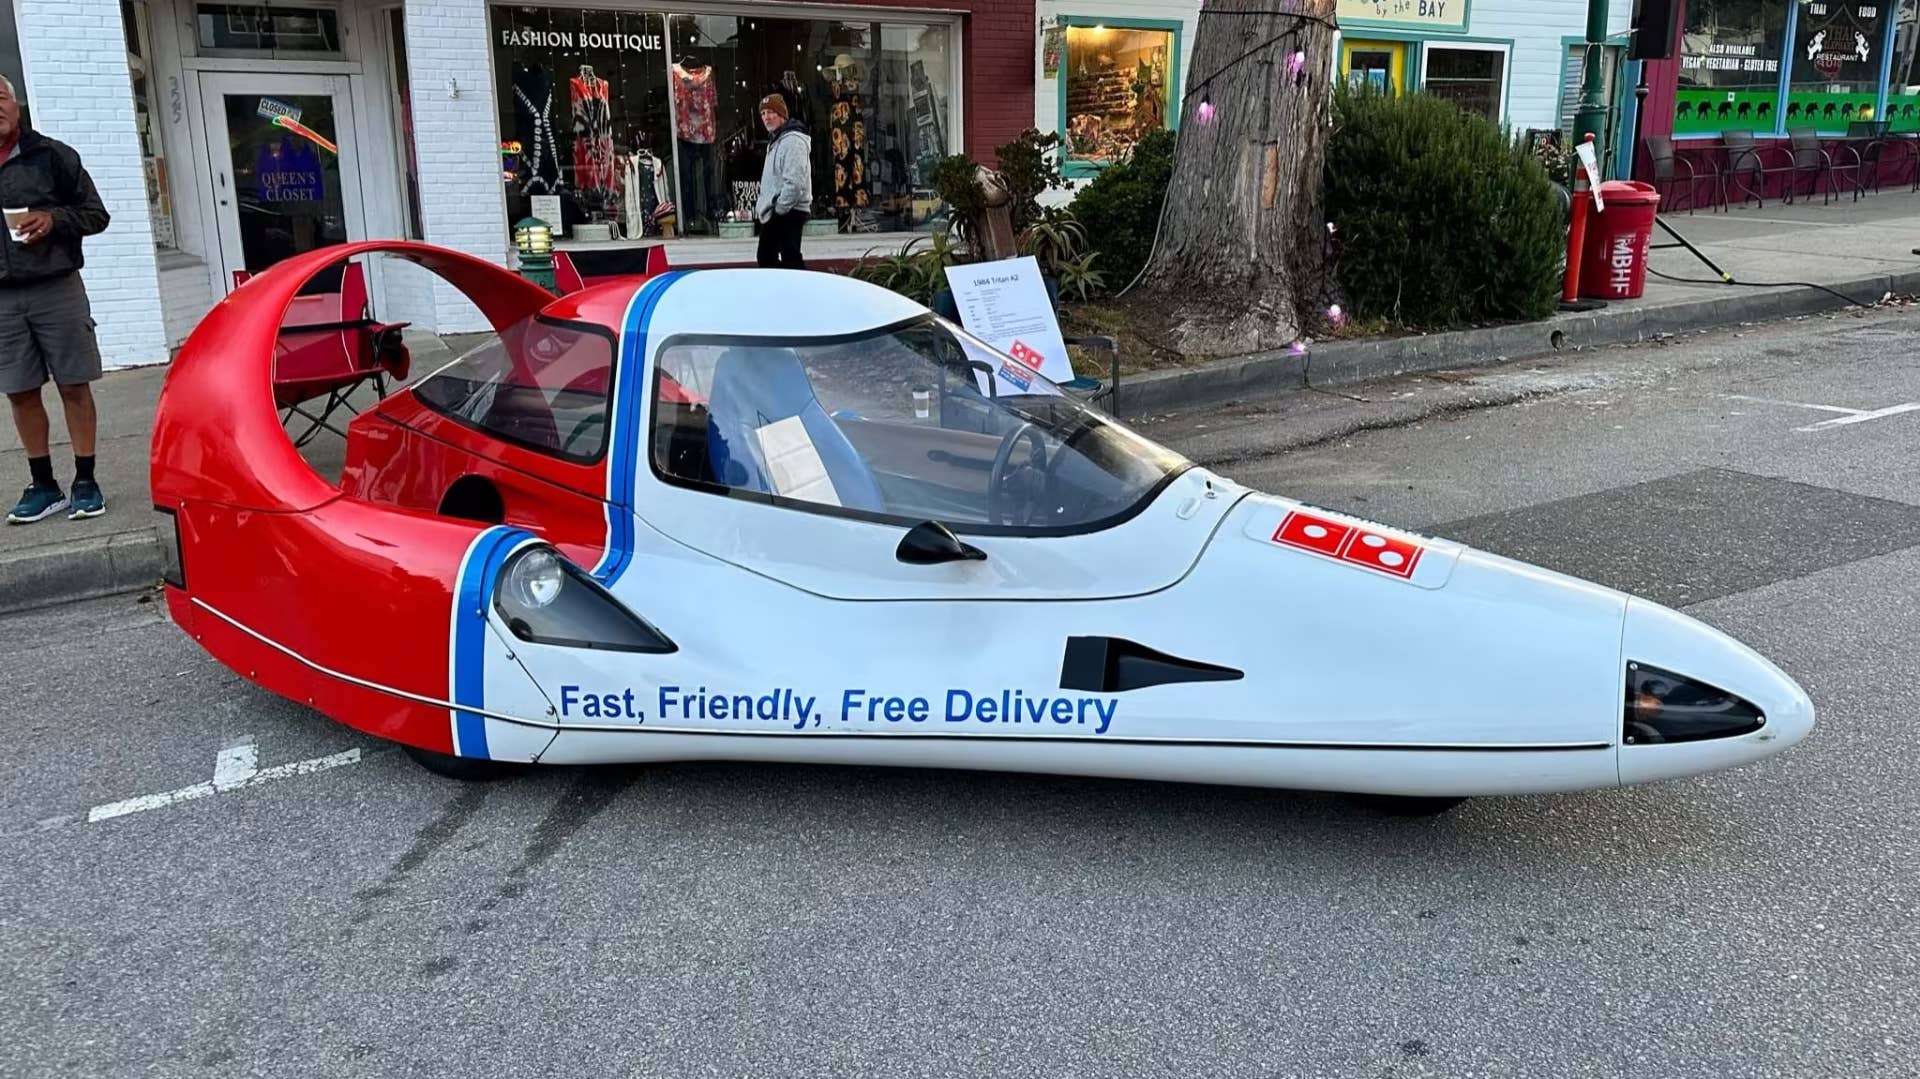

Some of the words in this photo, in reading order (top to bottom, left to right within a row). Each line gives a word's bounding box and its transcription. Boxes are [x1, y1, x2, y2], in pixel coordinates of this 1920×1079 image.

[1376, 5, 1387, 18] by
[1394, 0, 1410, 14] the
[1419, 0, 1445, 18] BAY
[1810, 3, 1827, 15] THAI
[1859, 6, 1877, 17] FOOD
[502, 30, 573, 47] FASHION
[579, 33, 662, 52] BOUTIQUE
[1709, 44, 1725, 54] ALSO
[1725, 45, 1756, 56] AVAILABLE
[1816, 53, 1859, 61] RESTAURANT
[1682, 56, 1701, 69] VEGAN
[1706, 57, 1740, 70] VEGETARIAN
[1744, 59, 1765, 71] GLUTEN
[1765, 60, 1778, 72] FREE
[260, 100, 288, 116] CLOSED
[262, 172, 316, 188] QUEEN'S
[266, 188, 315, 201] CLOSET
[560, 685, 645, 725] Fast,
[658, 686, 822, 730] Friendly,
[840, 689, 930, 723] Free
[944, 688, 1118, 734] Delivery
